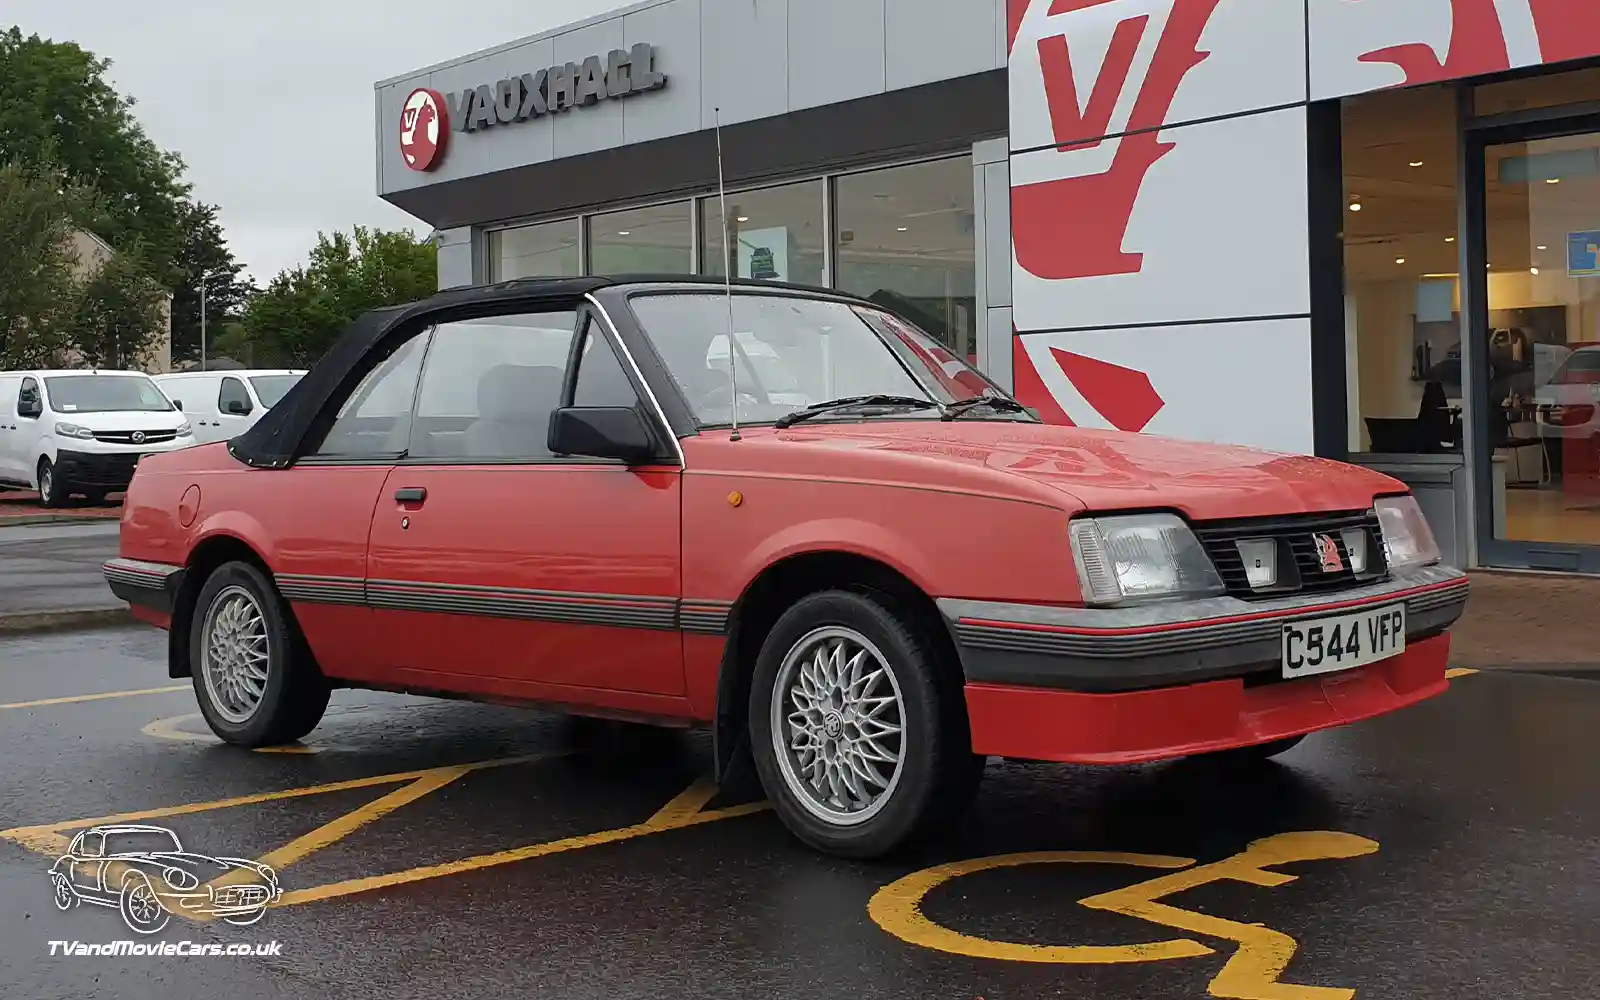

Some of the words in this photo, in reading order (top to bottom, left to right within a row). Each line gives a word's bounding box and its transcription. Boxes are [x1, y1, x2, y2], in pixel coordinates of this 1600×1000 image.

[447, 43, 666, 132] VAUXHALL
[1284, 622, 1360, 669] C544
[1368, 610, 1402, 653] VFP
